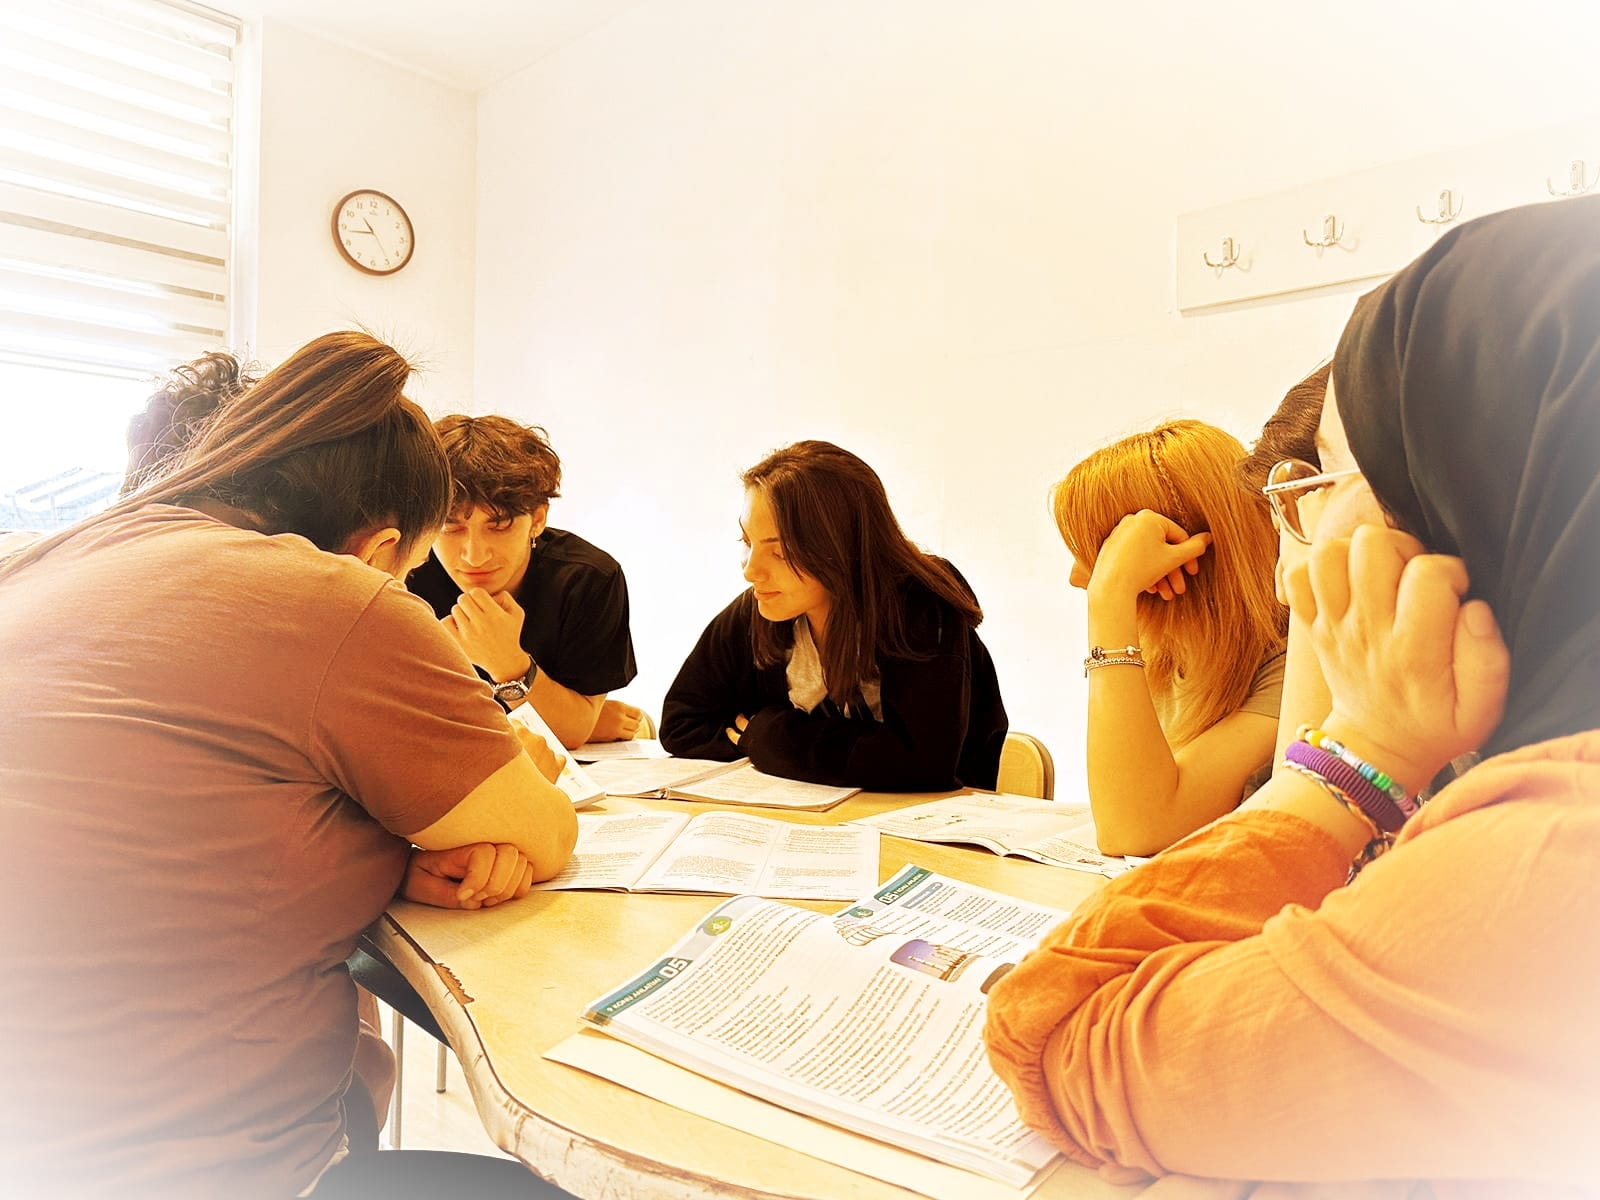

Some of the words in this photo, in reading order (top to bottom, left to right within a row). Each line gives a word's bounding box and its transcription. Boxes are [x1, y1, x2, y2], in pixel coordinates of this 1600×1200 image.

[370, 201, 378, 209] 12
[346, 210, 355, 218] 10
[879, 892, 900, 904] 05
[659, 958, 690, 979] 05
